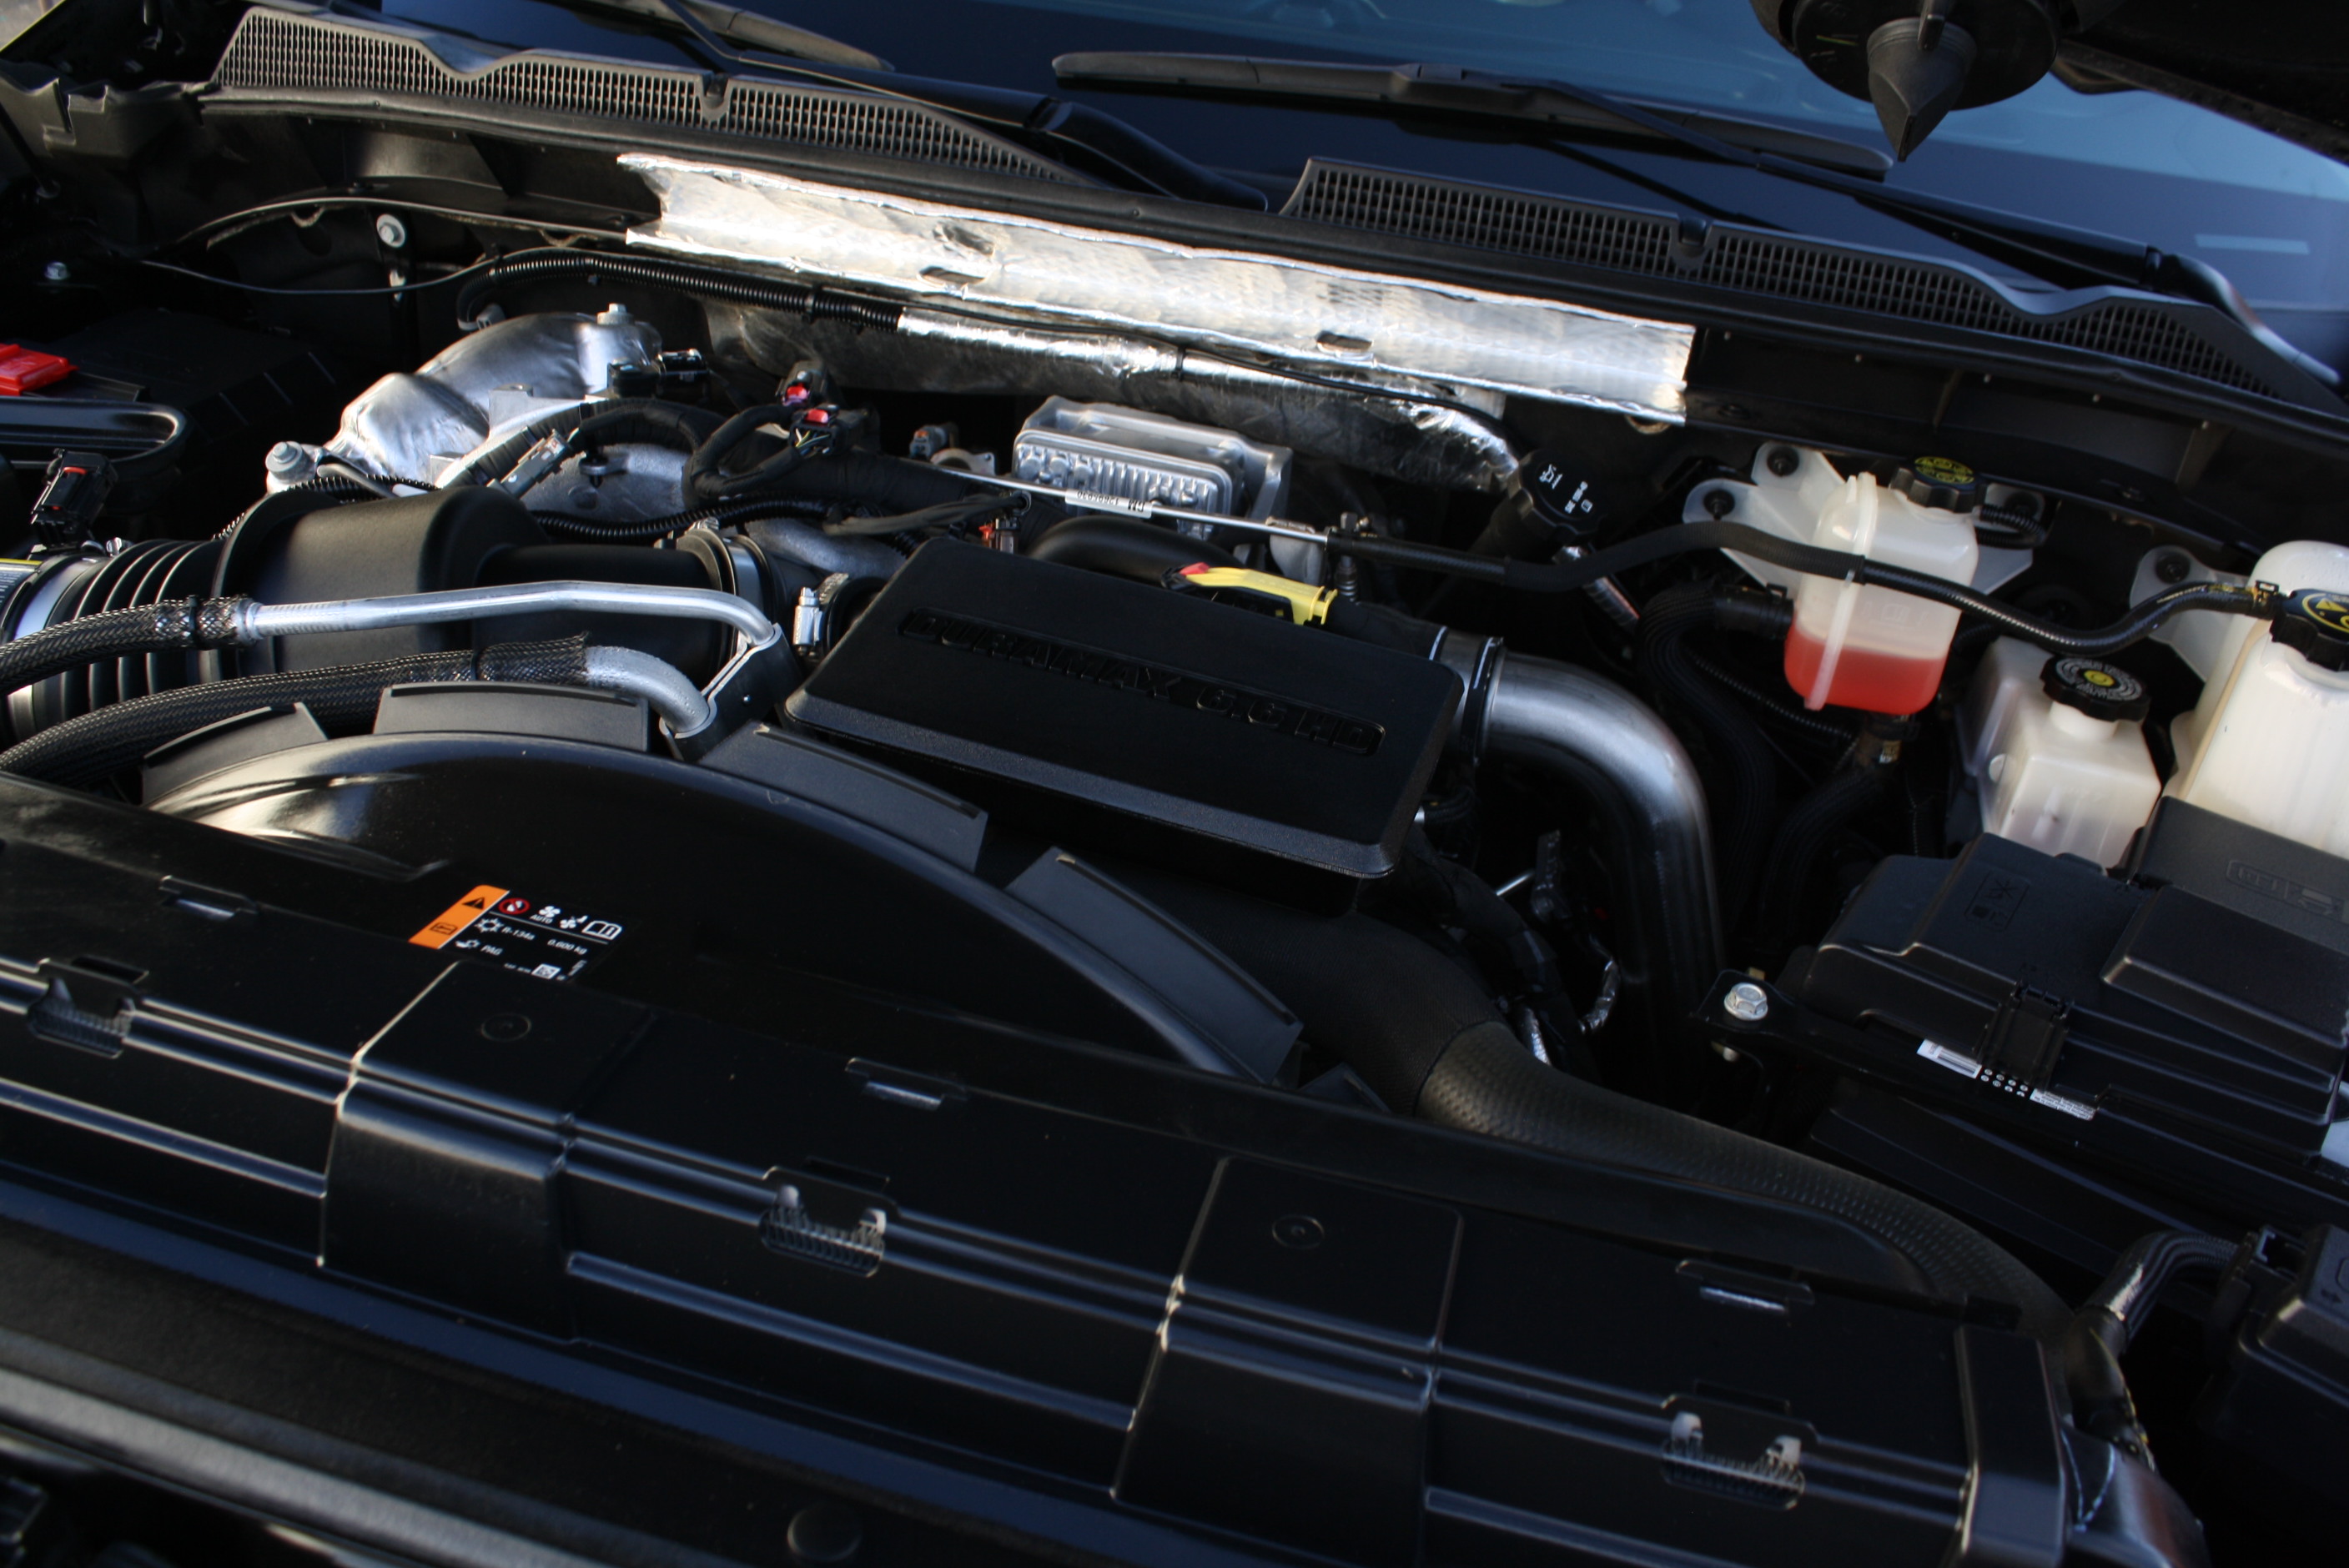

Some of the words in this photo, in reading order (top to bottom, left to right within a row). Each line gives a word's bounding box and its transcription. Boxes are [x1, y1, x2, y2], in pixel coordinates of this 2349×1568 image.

[904, 613, 1182, 700] DURAMAX
[1195, 683, 1290, 730] 6.6
[1294, 706, 1379, 751] HD
[530, 914, 553, 925] AUTO
[500, 926, 536, 942] R-134a
[480, 944, 504, 957] PAG
